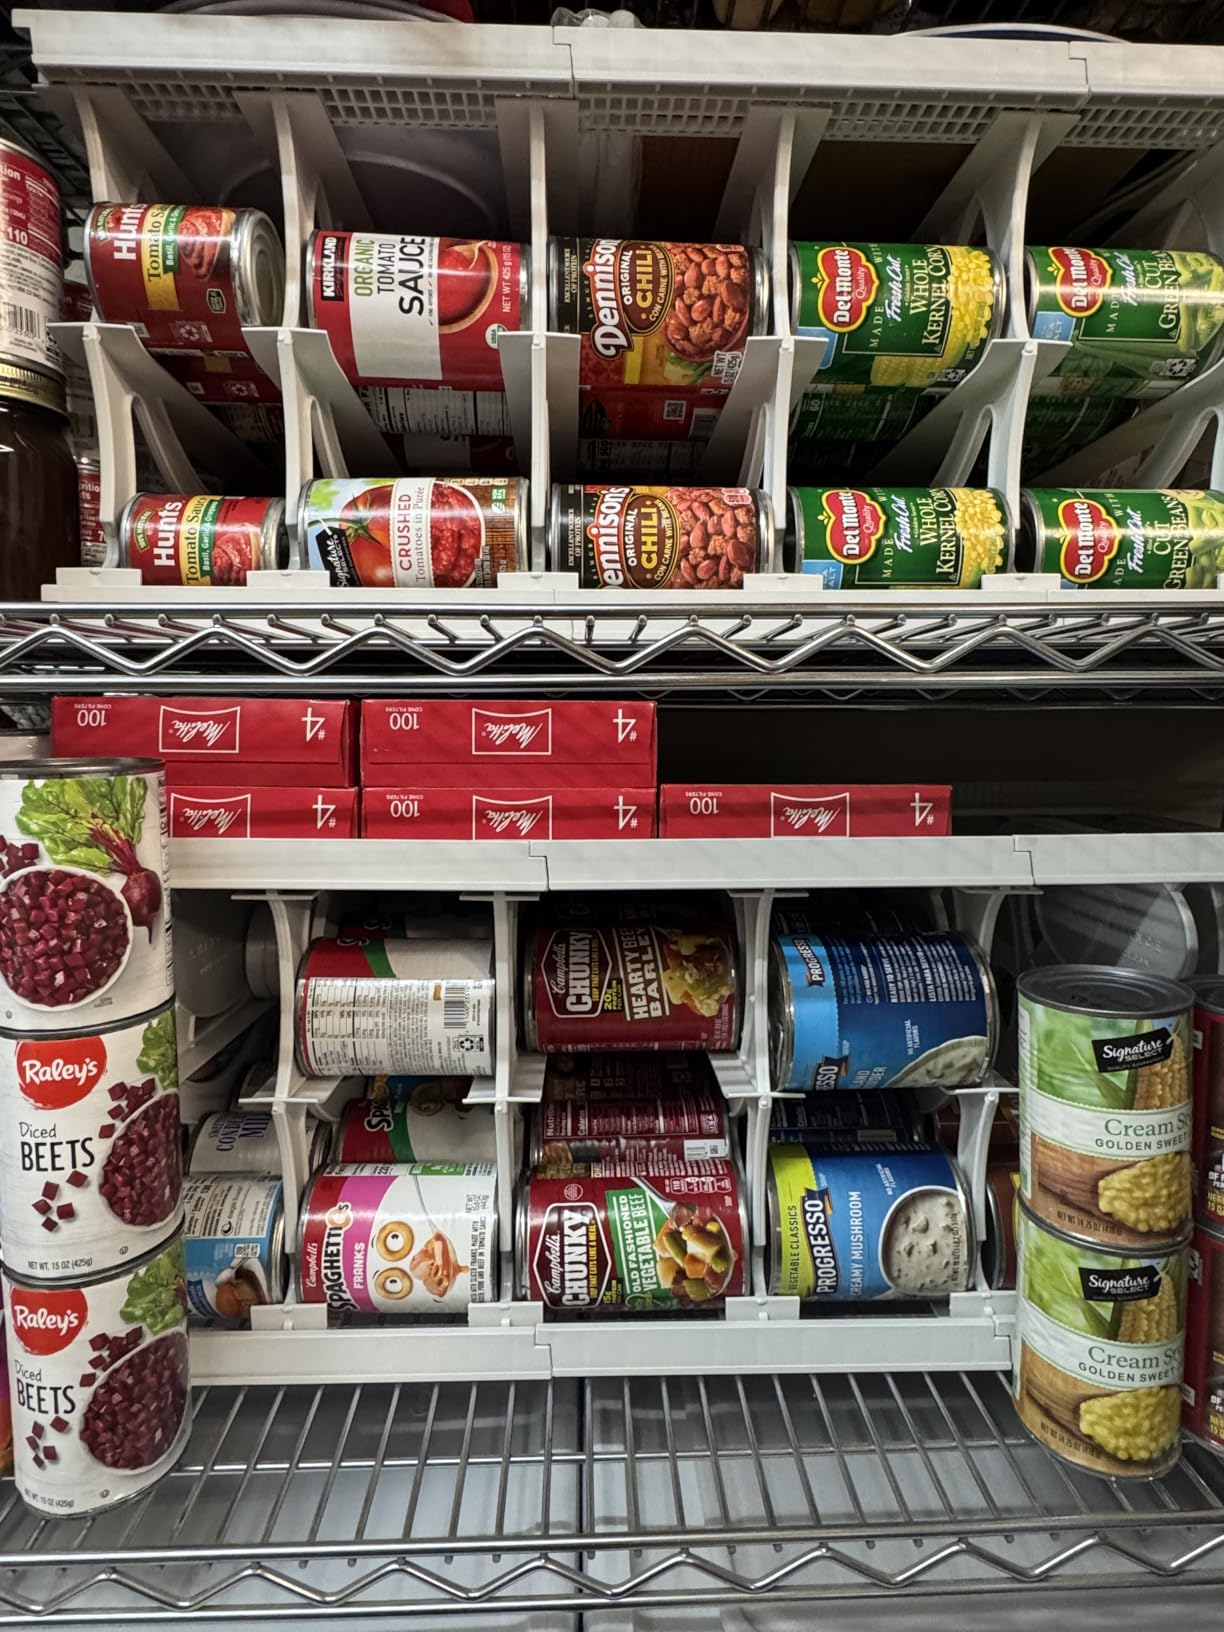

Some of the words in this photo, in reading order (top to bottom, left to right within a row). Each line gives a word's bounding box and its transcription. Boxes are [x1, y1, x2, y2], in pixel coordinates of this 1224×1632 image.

[147, 221, 162, 282] Tomato
[323, 236, 337, 297] KIRKLAND
[354, 239, 375, 297] ORGANIC
[377, 243, 396, 294] TOMATO
[398, 237, 425, 316] SAUCE
[619, 250, 633, 306] ORIGINAL
[635, 250, 654, 309] CHILI
[834, 248, 853, 293] Monte
[855, 267, 867, 299] Quality
[909, 258, 929, 315] WHOLE
[1090, 260, 1102, 285] Quality
[1142, 260, 1162, 289] CUT
[502, 281, 511, 295] WT
[502, 297, 511, 312] NET
[649, 307, 662, 322] CON
[656, 281, 668, 308] CARNE
[885, 282, 903, 322] Fresh
[1120, 270, 1138, 306] Fresh
[1158, 274, 1180, 328] GREEN
[833, 293, 852, 323] Del
[922, 282, 946, 345] KERNEL
[868, 305, 884, 348] MADE
[713, 365, 726, 376] NET
[715, 352, 726, 363] WT
[189, 496, 208, 524] Sauce
[413, 486, 425, 512] Purée
[1104, 493, 1122, 517] WITH
[1161, 494, 1188, 536] BEANS
[398, 494, 412, 572] CRUSHED
[413, 512, 424, 527] in
[664, 520, 674, 539] WITH
[862, 505, 874, 533] Quality
[893, 516, 913, 553] Fresh
[918, 497, 937, 546] WHOLE
[1074, 502, 1094, 544] Monte
[202, 528, 214, 549] Garlic
[588, 487, 630, 589] ennison's
[627, 508, 638, 567] ORIGINAL
[640, 507, 658, 569] CHILI
[662, 540, 673, 565] CARNE
[842, 529, 860, 557] Del
[936, 515, 956, 574] KERNEL
[1097, 520, 1109, 553] Quality
[1153, 521, 1172, 555] CUT
[186, 528, 199, 585] Tomato
[201, 549, 211, 571] Basil,
[327, 537, 349, 587] Signature
[414, 528, 426, 583] Tomatoes
[881, 538, 894, 578] MADE
[1074, 544, 1094, 576] Del
[1126, 535, 1144, 573] Fresh
[1162, 537, 1188, 590] GREEN
[654, 565, 665, 581] CON
[1114, 558, 1126, 585] ADE
[77, 710, 108, 727] 100
[171, 720, 231, 747] Melitta
[302, 707, 326, 742] #4
[389, 713, 420, 730] 100
[613, 708, 637, 744] #4
[484, 723, 544, 749] Melitta
[183, 808, 242, 835] Melitta
[312, 794, 337, 830] #4
[390, 801, 420, 818] 100
[484, 810, 544, 836] Melitta
[613, 795, 638, 830] #4
[689, 797, 719, 815] 100
[784, 807, 842, 833] Melitta
[910, 792, 935, 826] #4
[551, 943, 566, 995] Campbell's
[566, 931, 593, 1012] CHUNKY
[625, 951, 649, 1020] HEARTY
[636, 928, 663, 1018] BARLEY
[1102, 1037, 1164, 1062] Signature
[1124, 1048, 1163, 1062] SELECT
[22, 1057, 98, 1086] Raley's
[19, 1121, 57, 1139] Diced
[1095, 1137, 1151, 1151] GOLDEN
[1156, 1134, 1188, 1150] SWEET
[1104, 1117, 1174, 1138] Cream
[20, 1137, 95, 1172] BEETS
[631, 1193, 646, 1218] BEEF
[588, 1224, 597, 1241] MEAL
[619, 1194, 637, 1268] FASHIONED
[787, 1204, 799, 1250] CLASSICS
[849, 1191, 864, 1259] MUSHROOM
[545, 1230, 561, 1294] Campbell's
[562, 1209, 590, 1306] CHUNKY
[589, 1246, 598, 1260] LIKE
[637, 1219, 657, 1292] VEGETABLE
[804, 1198, 837, 1294] PROGRESSO
[52, 1262, 60, 1270] 15
[61, 1260, 70, 1269] OZ
[72, 1257, 93, 1270] (425g)
[305, 1242, 318, 1288] Campbell's
[353, 1242, 366, 1289] FRANKS
[589, 1260, 598, 1274] EATS
[589, 1274, 598, 1287] THAT
[629, 1265, 640, 1292] OLD
[788, 1252, 800, 1291] VEGETABLE
[850, 1260, 863, 1296] CREAMY
[1088, 1274, 1151, 1294] Signature
[1110, 1284, 1150, 1295] SELECT
[14, 1304, 79, 1336] Raley's
[14, 1359, 42, 1382] Diced
[1078, 1361, 1135, 1383] GOLDEN
[1139, 1366, 1175, 1383] SWEET
[1088, 1345, 1160, 1369] Cream
[16, 1378, 76, 1415] BEETS
